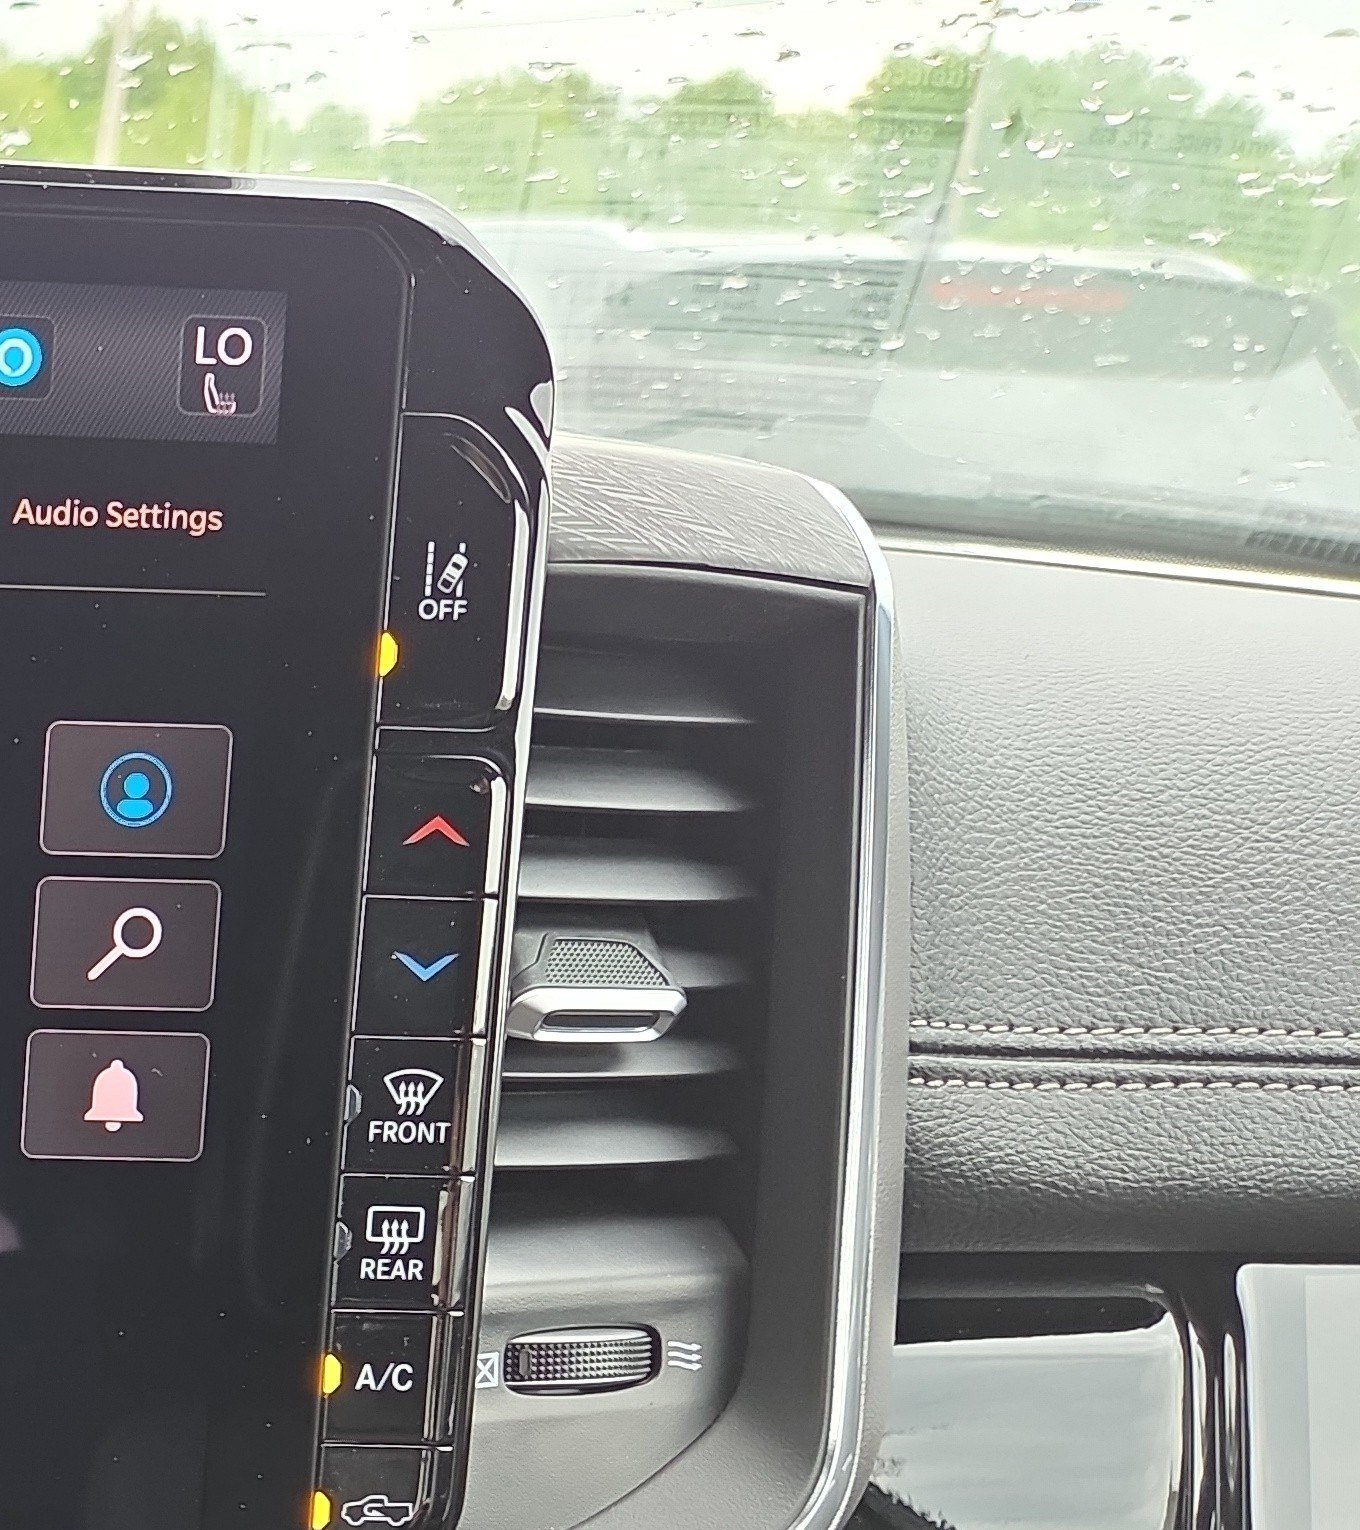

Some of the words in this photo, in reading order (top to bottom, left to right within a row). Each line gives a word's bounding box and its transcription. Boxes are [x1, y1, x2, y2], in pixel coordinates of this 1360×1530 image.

[195, 327, 253, 367] LO
[13, 498, 98, 529] Audio
[106, 502, 224, 537] Settings
[419, 598, 467, 621] OFF
[368, 1121, 451, 1144] FRONT
[360, 1258, 424, 1281] REAR
[355, 1363, 414, 1391] A/C
